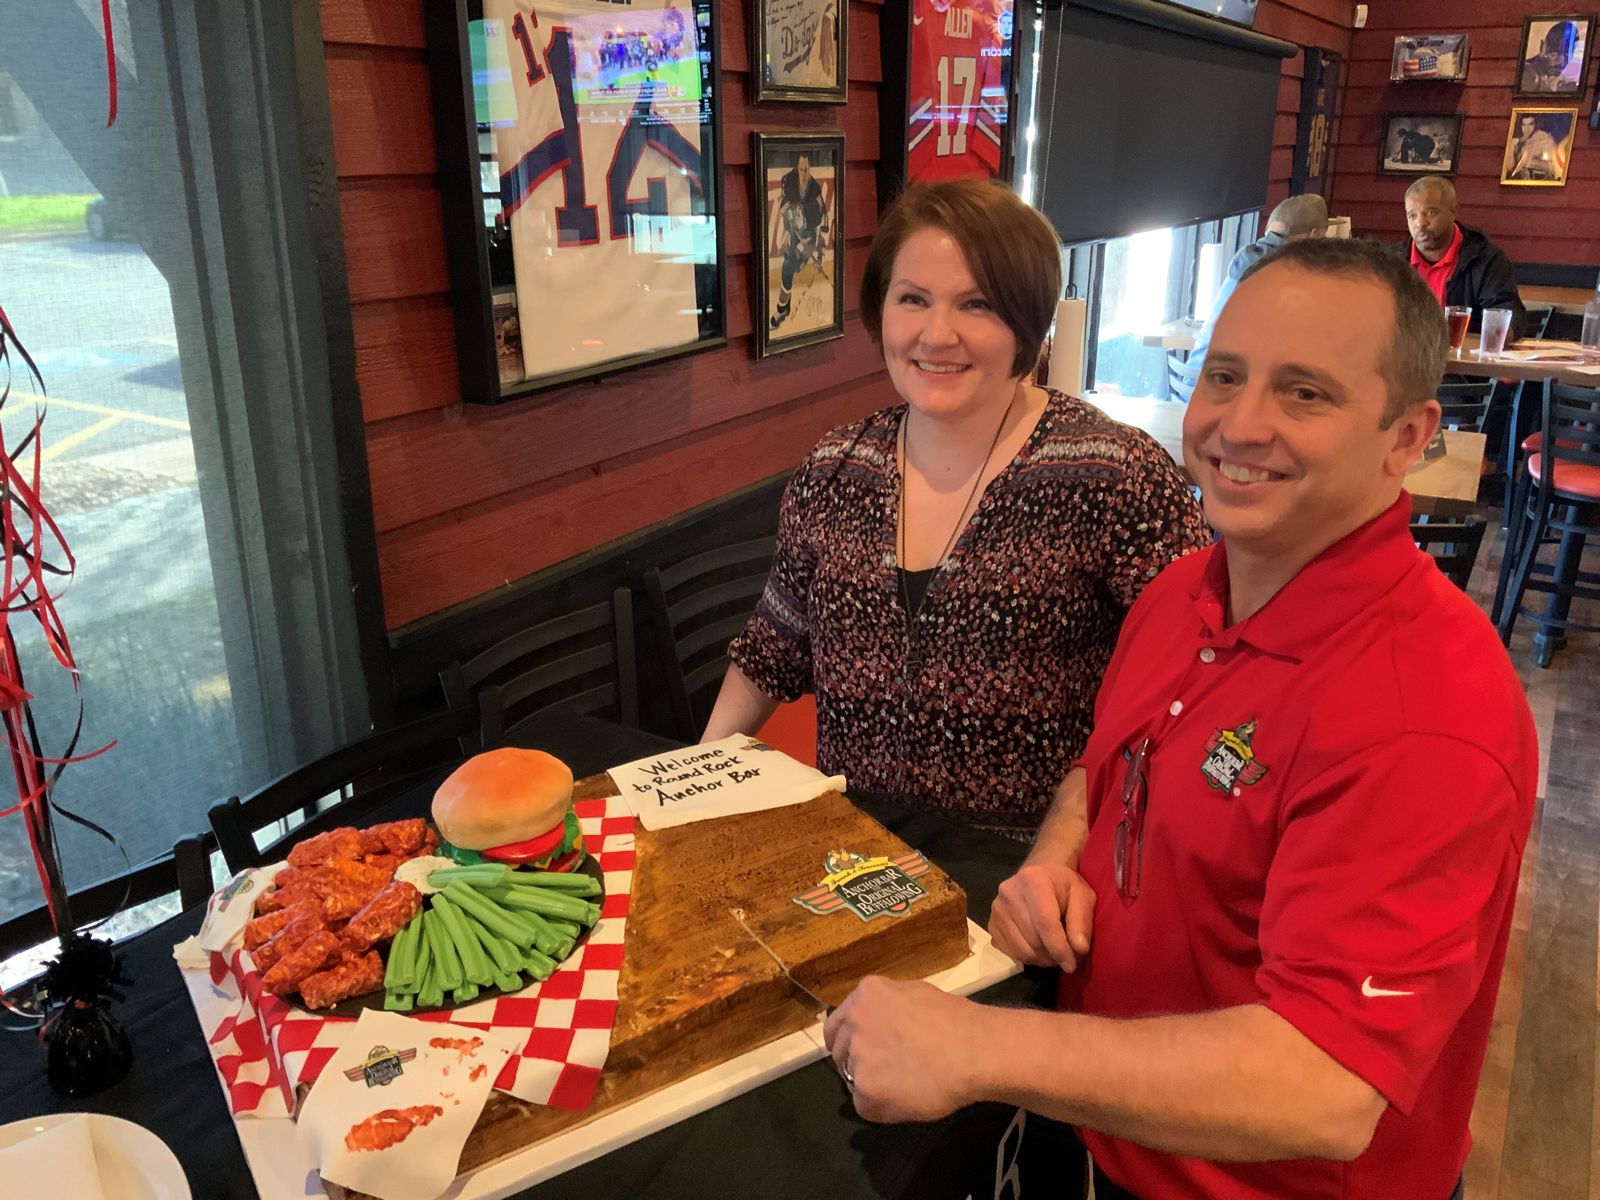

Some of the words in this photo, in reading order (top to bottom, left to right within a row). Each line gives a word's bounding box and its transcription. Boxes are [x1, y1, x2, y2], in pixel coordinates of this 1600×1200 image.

[937, 56, 976, 156] 17
[632, 783, 652, 793] to
[652, 767, 705, 786] Round
[701, 756, 745, 774] Rock
[637, 749, 725, 776] Welcome
[656, 780, 723, 807] Anchor
[727, 768, 761, 784] Bar
[840, 877, 884, 898] ANCHOR
[880, 868, 902, 882] BAR
[856, 894, 900, 915] BUFFALO
[895, 882, 922, 900] WING
[858, 881, 906, 904] ORIGINAL
